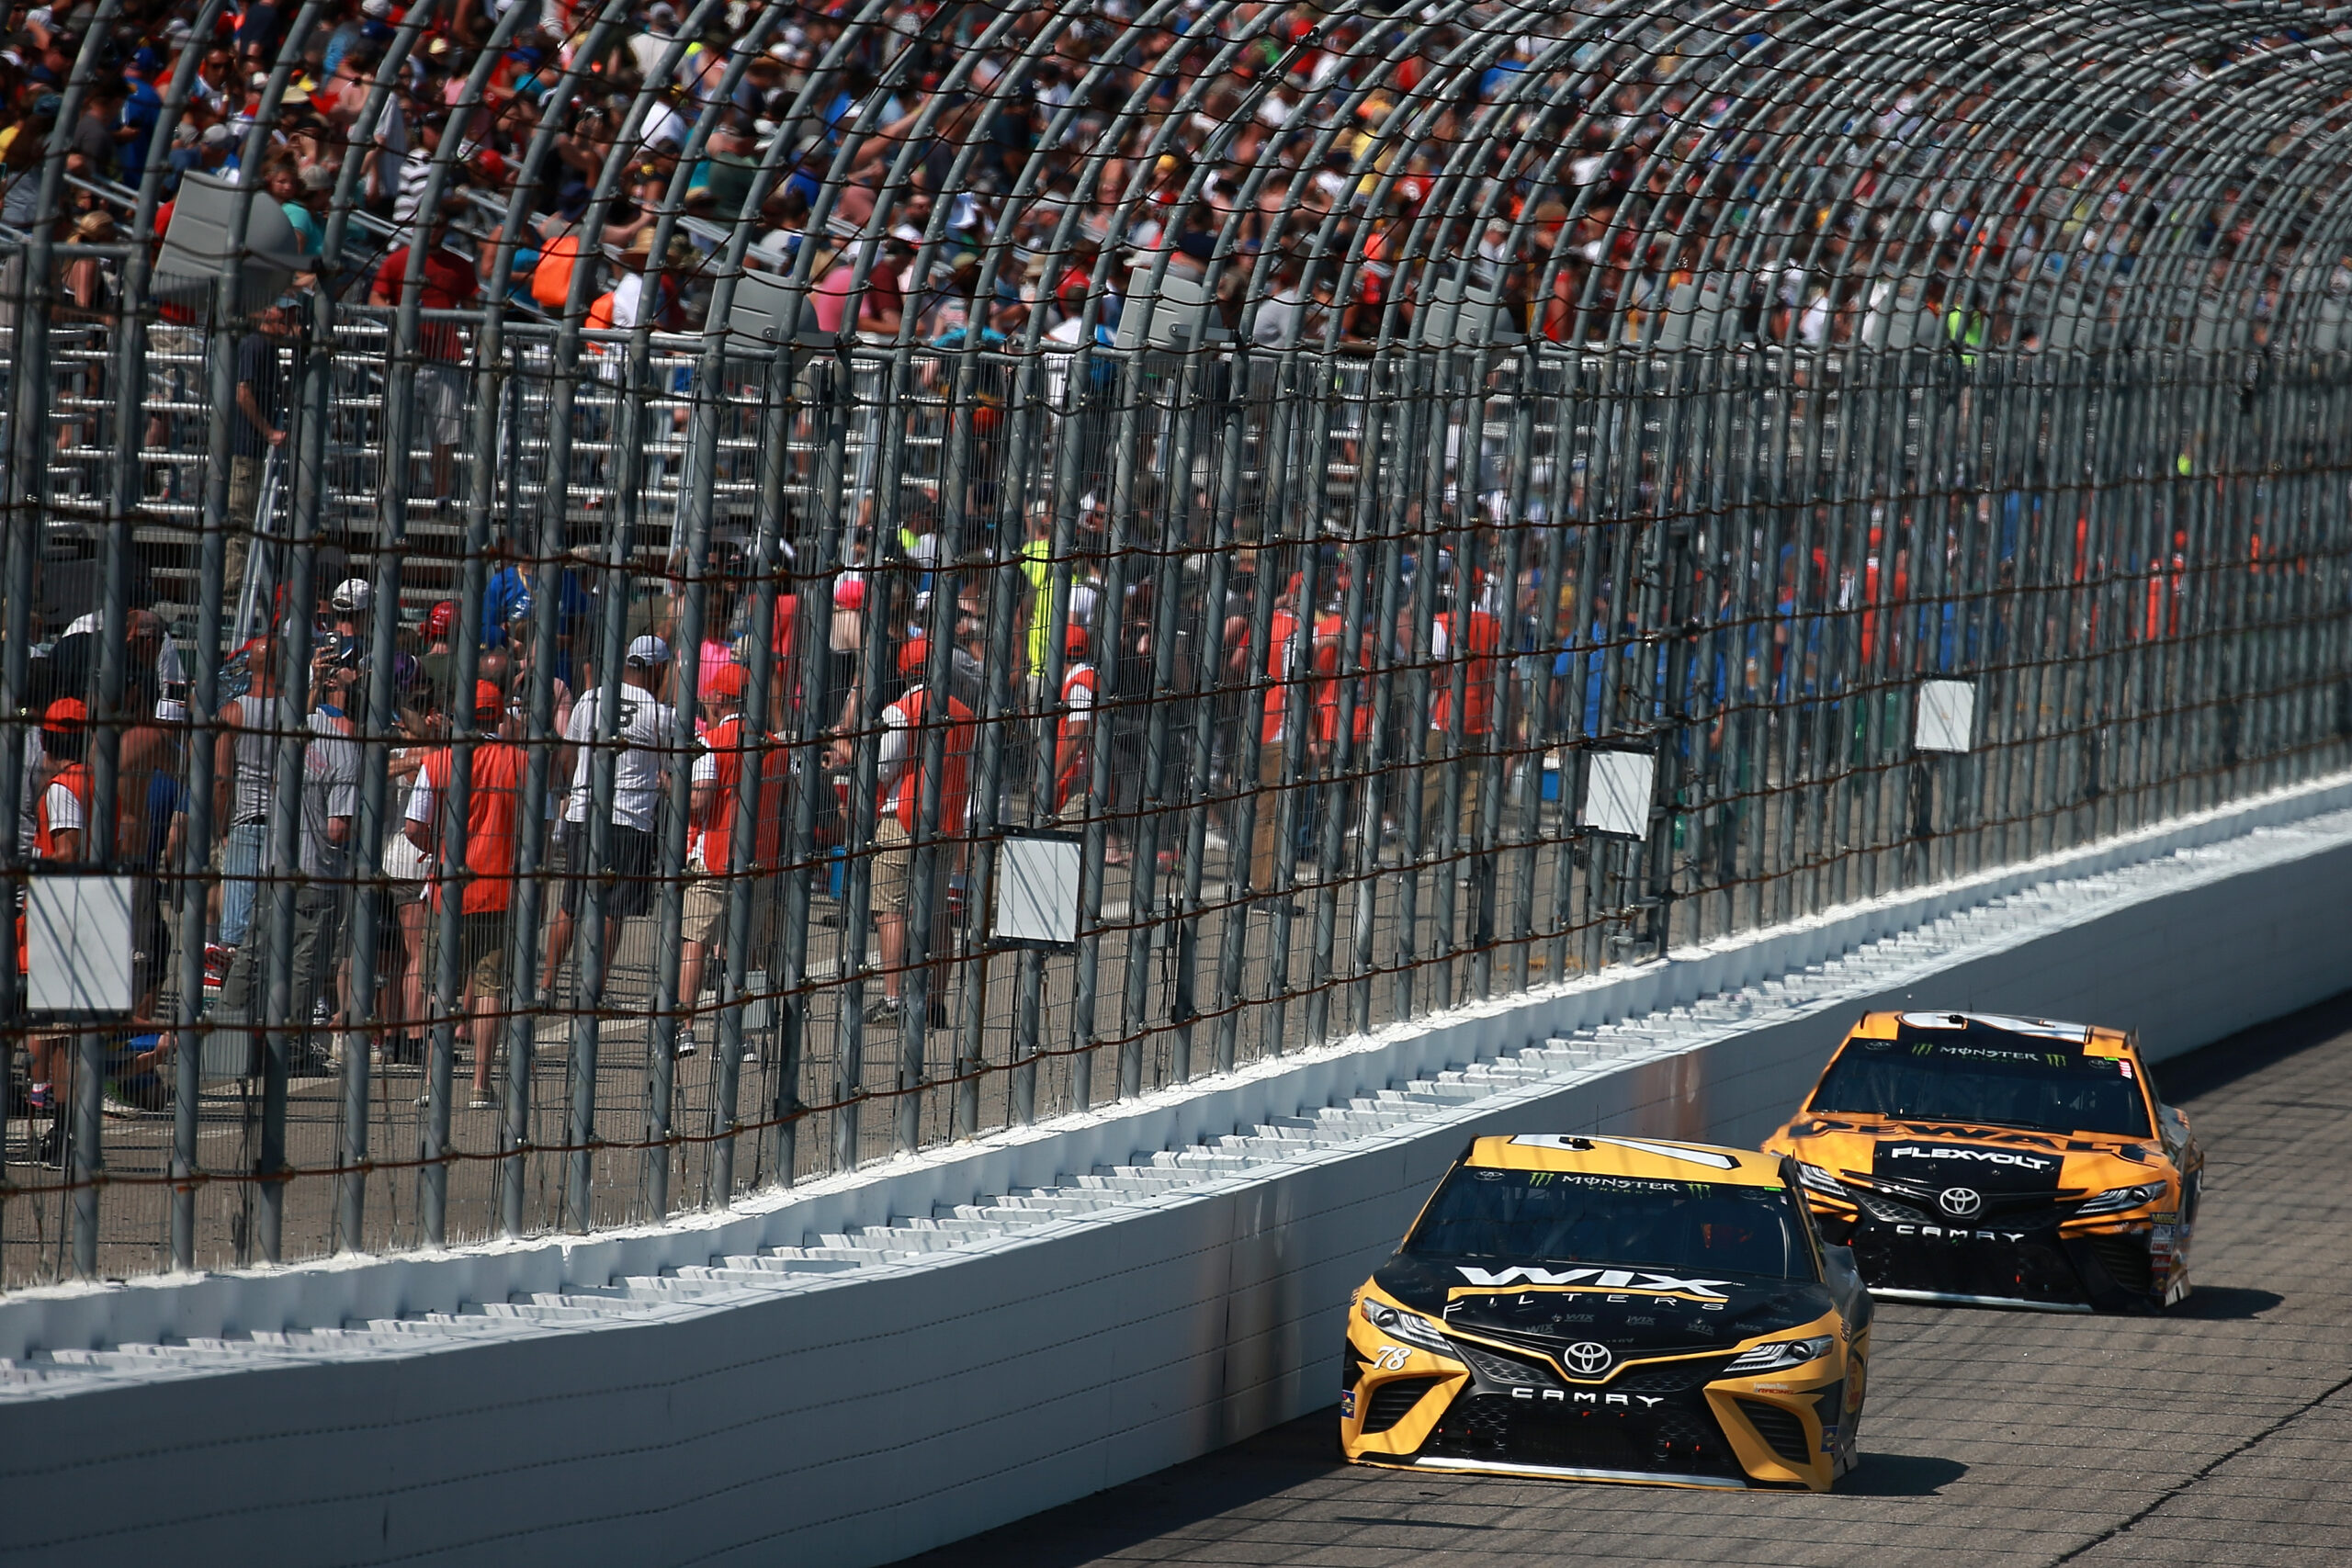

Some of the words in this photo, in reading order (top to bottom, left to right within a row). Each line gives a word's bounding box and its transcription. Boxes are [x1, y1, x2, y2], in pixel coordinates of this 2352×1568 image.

[1939, 1045, 2040, 1062] MONSTER
[1891, 1145, 2052, 1170] FLEXVOLT
[1561, 1175, 1679, 1192] MONSTER
[1895, 1224, 2025, 1243] CAMRY
[1454, 1266, 1733, 1298] WIX
[1442, 1292, 1725, 1321] FILTERS
[1374, 1345, 1412, 1371] 78
[1511, 1387, 1665, 1408] CAMRY
